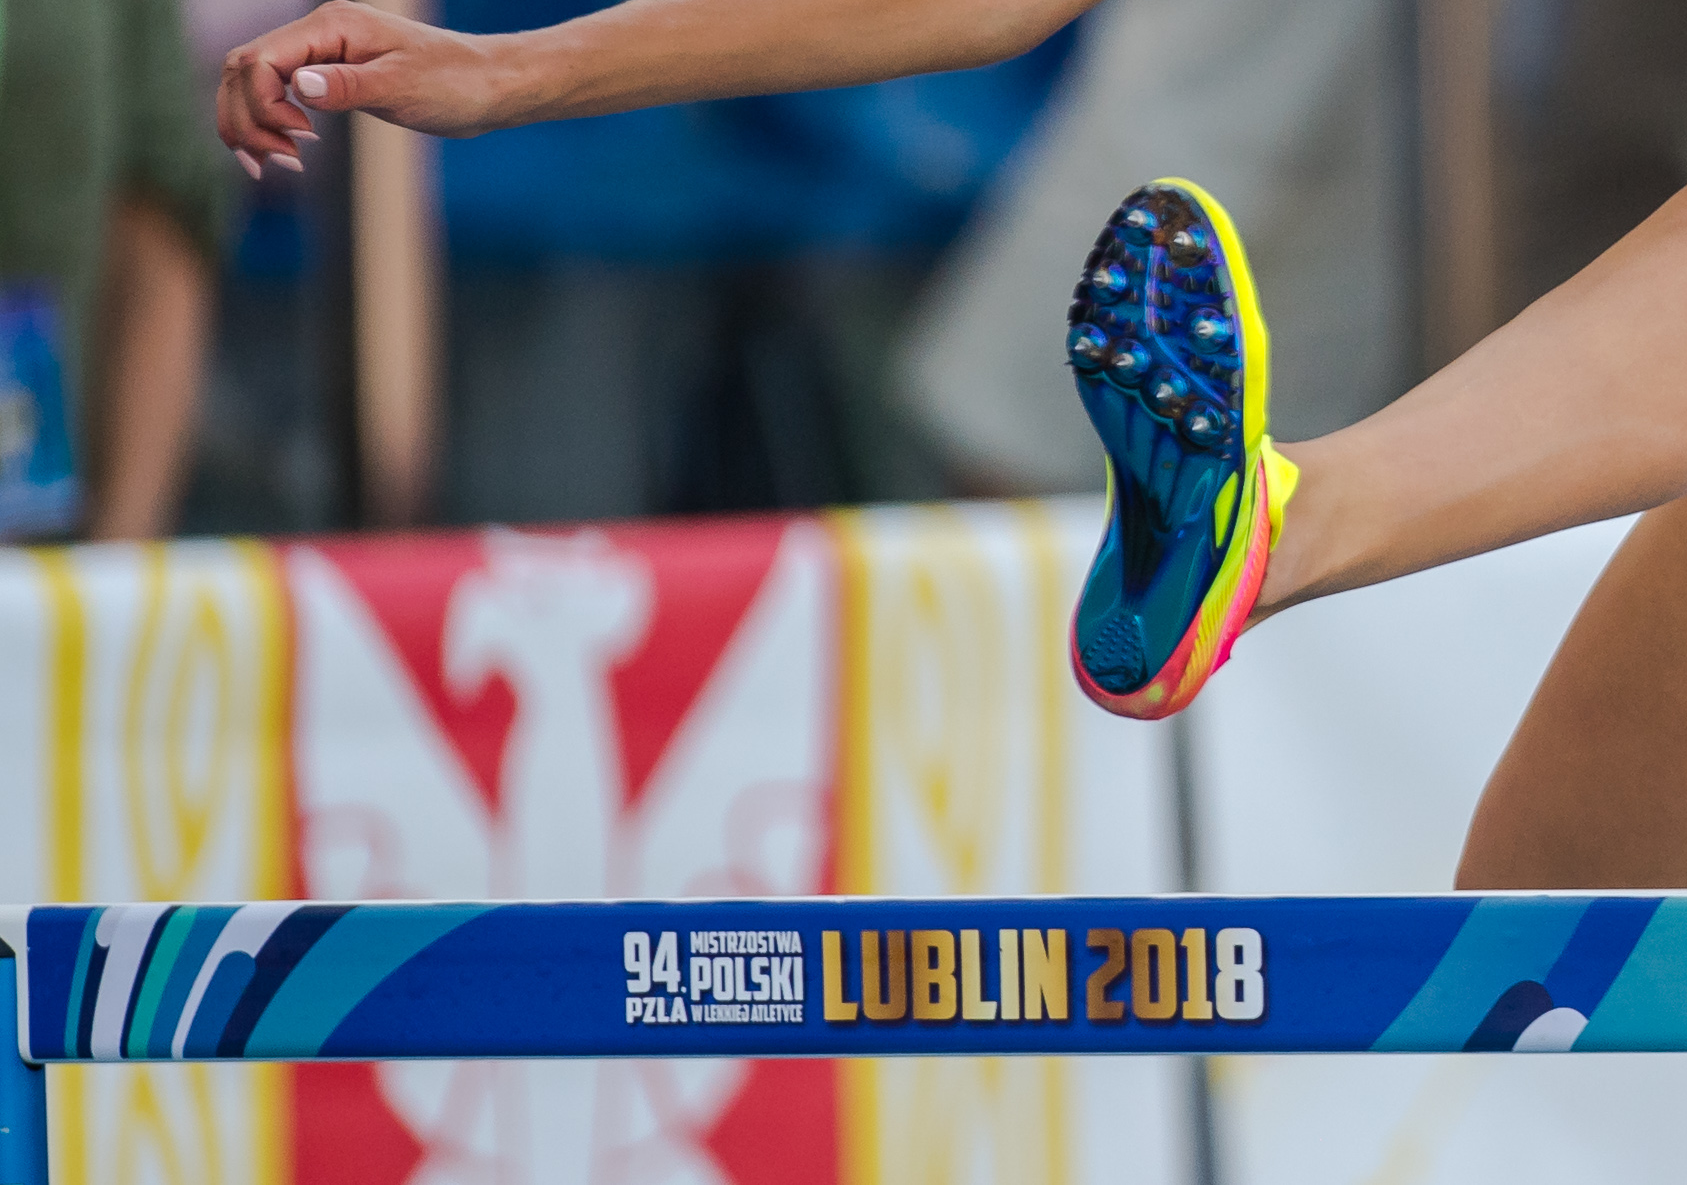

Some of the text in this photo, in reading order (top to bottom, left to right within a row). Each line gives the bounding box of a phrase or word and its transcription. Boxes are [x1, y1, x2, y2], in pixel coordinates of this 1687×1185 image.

[690, 930, 803, 954] MISTRZOSTWA
[623, 931, 687, 993] 94.
[690, 956, 804, 1001] POLSKI
[821, 927, 1264, 1021] LUBLIN 2018
[626, 996, 688, 1024] PZLA
[691, 1004, 804, 1023] W LEKKIEJ ATLETYCE
